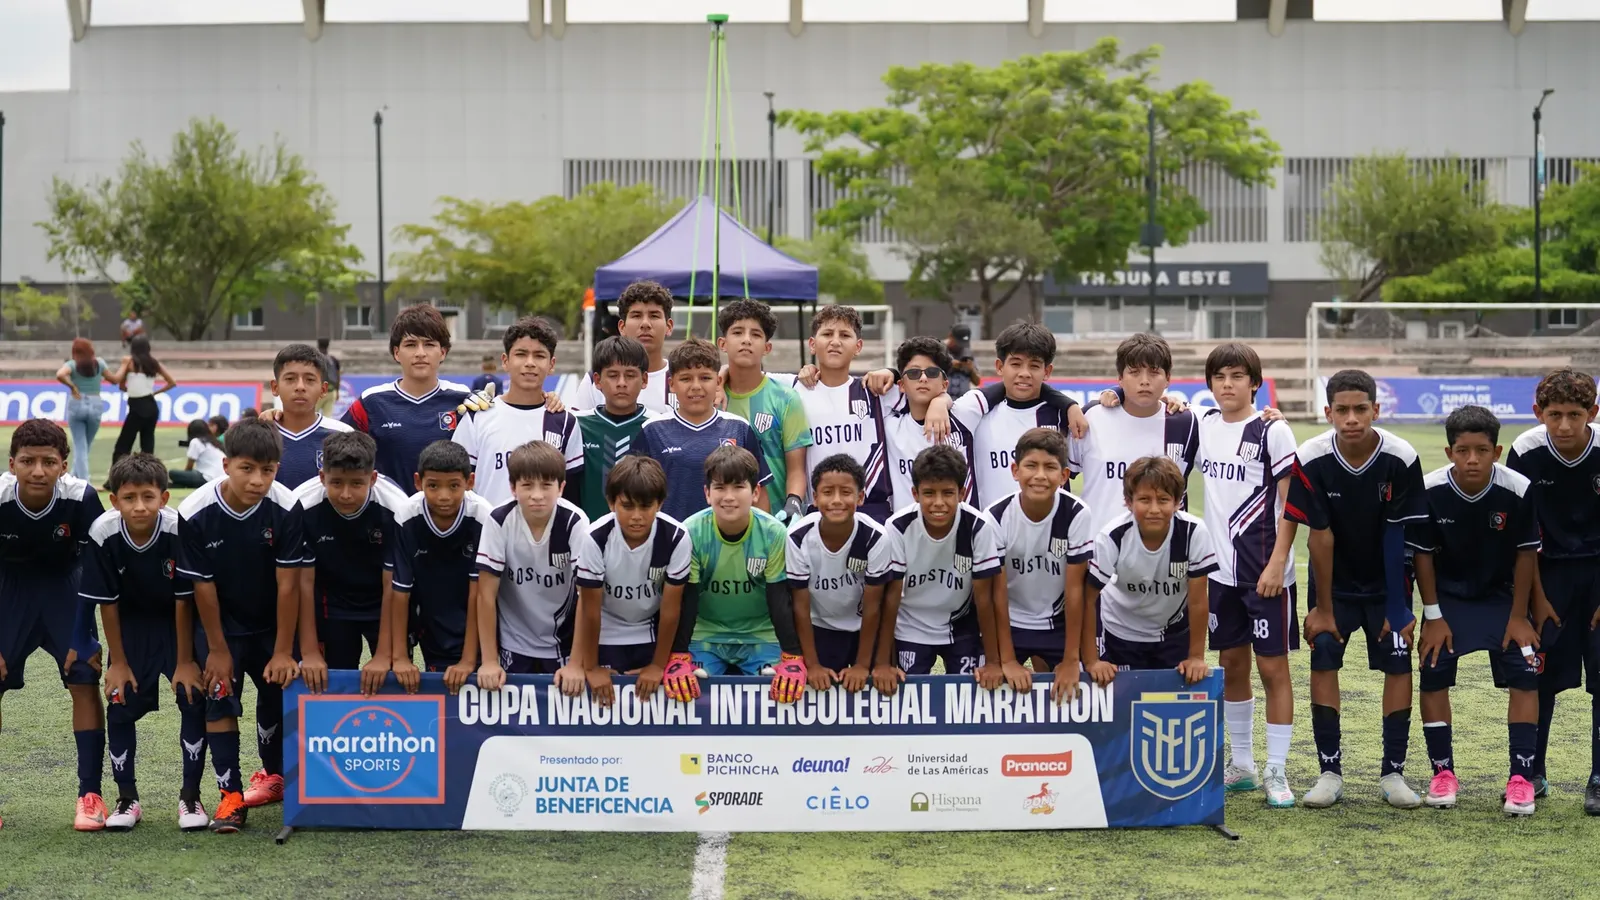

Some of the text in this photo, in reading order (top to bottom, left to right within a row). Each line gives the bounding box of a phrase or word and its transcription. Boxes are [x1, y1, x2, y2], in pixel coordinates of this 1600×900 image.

[1078, 270, 1231, 286] TRBUNA ESTE
[810, 423, 862, 446] OSTON
[508, 566, 565, 588] BOSTON
[908, 568, 963, 590] BOSTON
[704, 580, 754, 595] OSTO
[1127, 580, 1180, 596] BOTON
[1252, 618, 1269, 639] 48
[458, 684, 540, 726] COPA
[710, 683, 937, 725] INTERCOLEGIAL
[945, 682, 1114, 724] MARATHON
[308, 731, 436, 753] marathon
[344, 758, 401, 771] SPORTS
[540, 755, 623, 766] Presentado por:
[707, 753, 753, 763] BANCO
[792, 757, 850, 773] deuna!
[907, 753, 968, 763] Universidad
[1006, 759, 1067, 772] Pronaca
[707, 765, 779, 775] PICHINCHA
[907, 764, 989, 775] de Las Américas
[535, 776, 600, 793] JUNTA
[604, 776, 630, 793] DE
[535, 797, 674, 814] BENEFICENCIA
[709, 791, 763, 806] SPORADE
[931, 793, 982, 807] Hispana
